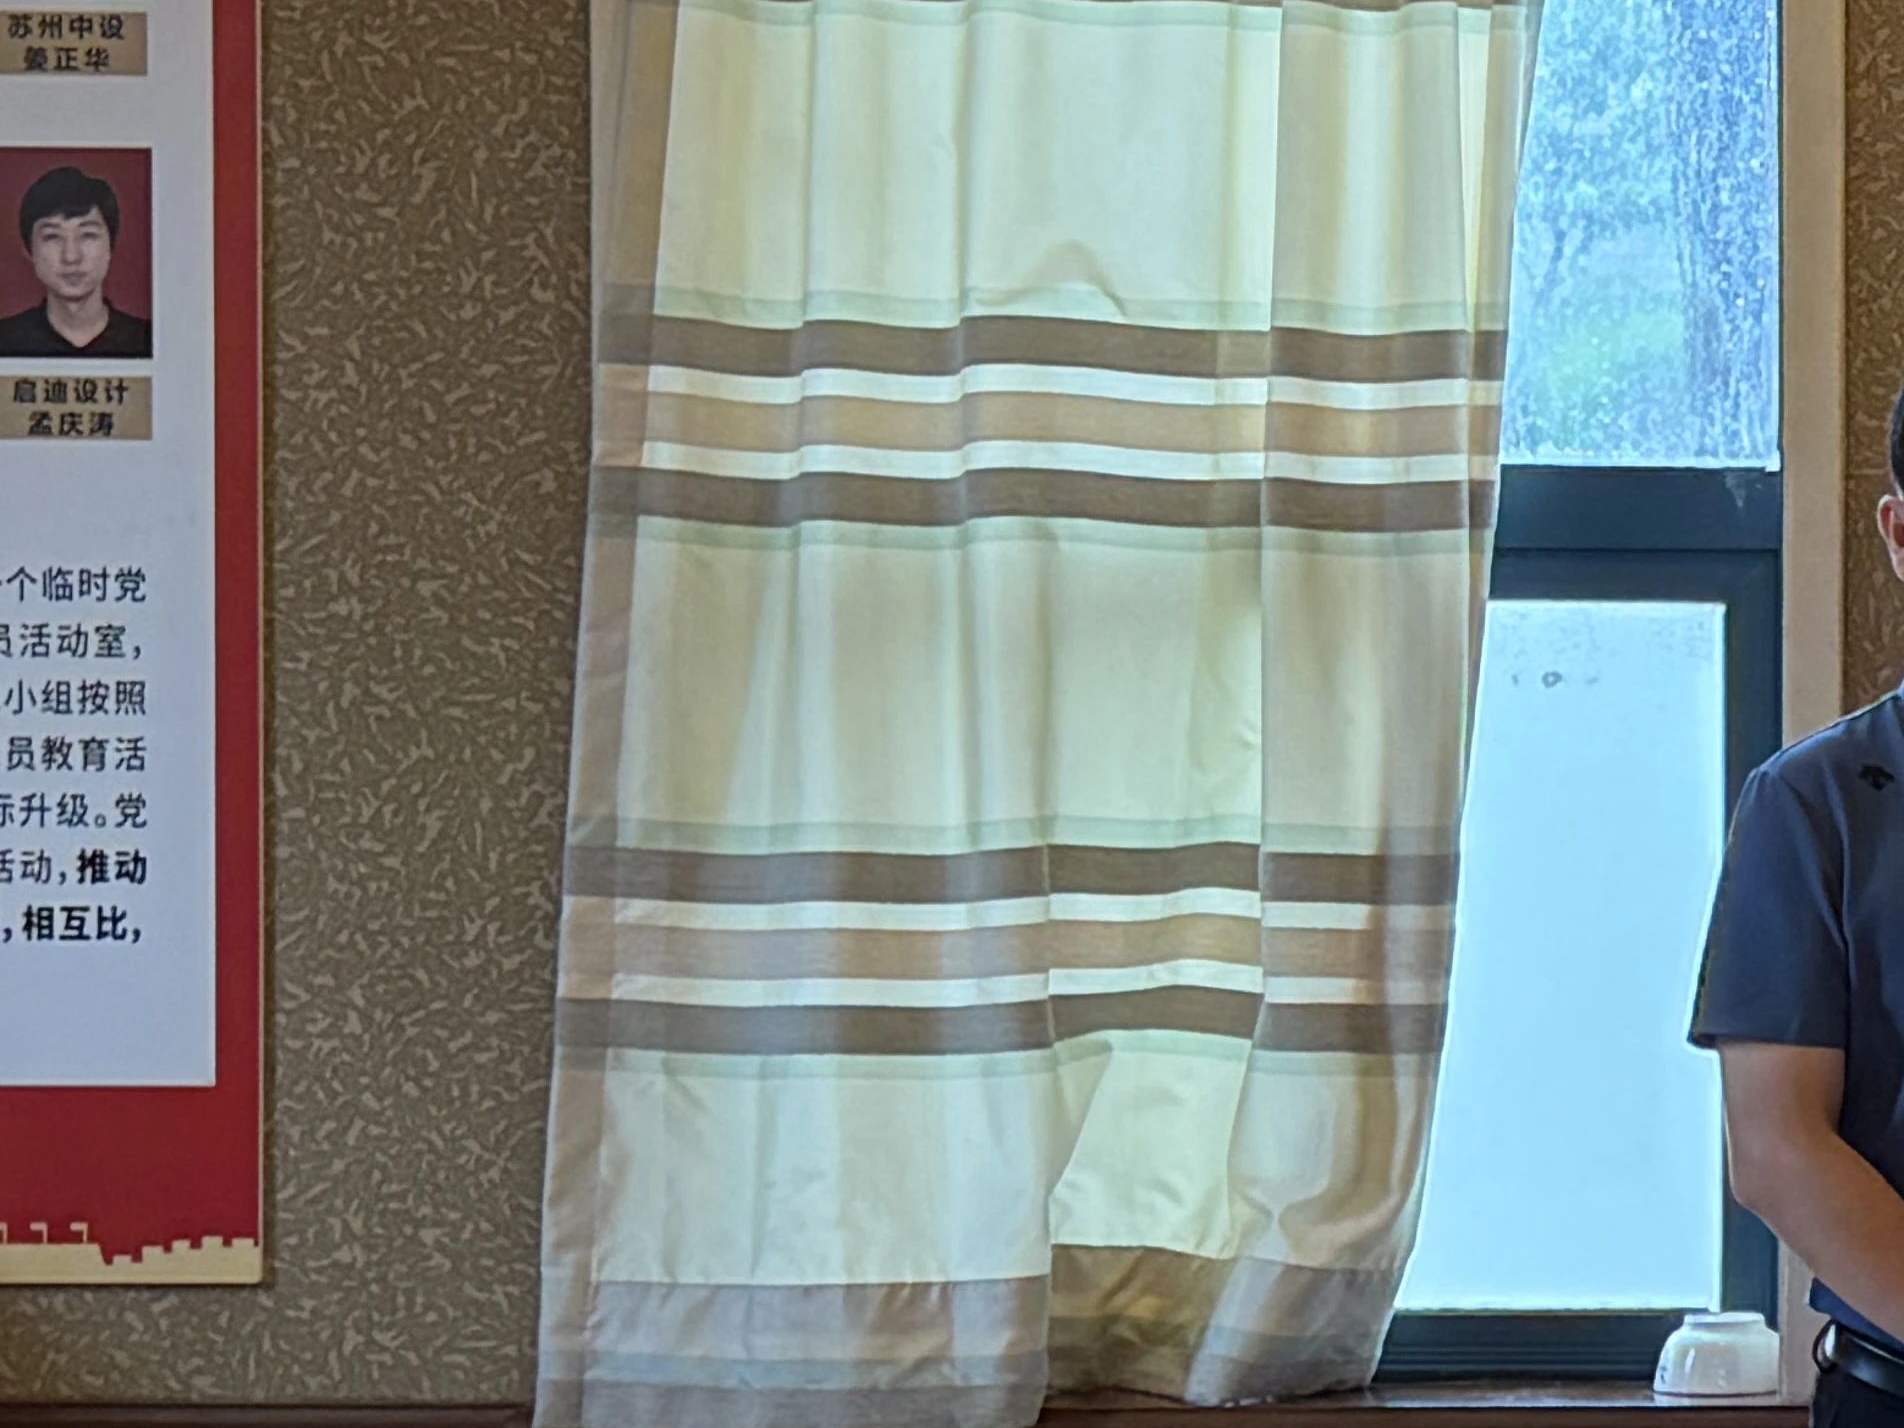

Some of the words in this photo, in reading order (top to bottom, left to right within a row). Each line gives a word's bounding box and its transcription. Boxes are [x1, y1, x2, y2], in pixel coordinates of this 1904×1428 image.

[8, 14, 124, 40] 苏州中设
[13, 379, 129, 406] 启迪设计
[4, 679, 147, 715] 小组按照
[7, 736, 147, 772] 员教育活
